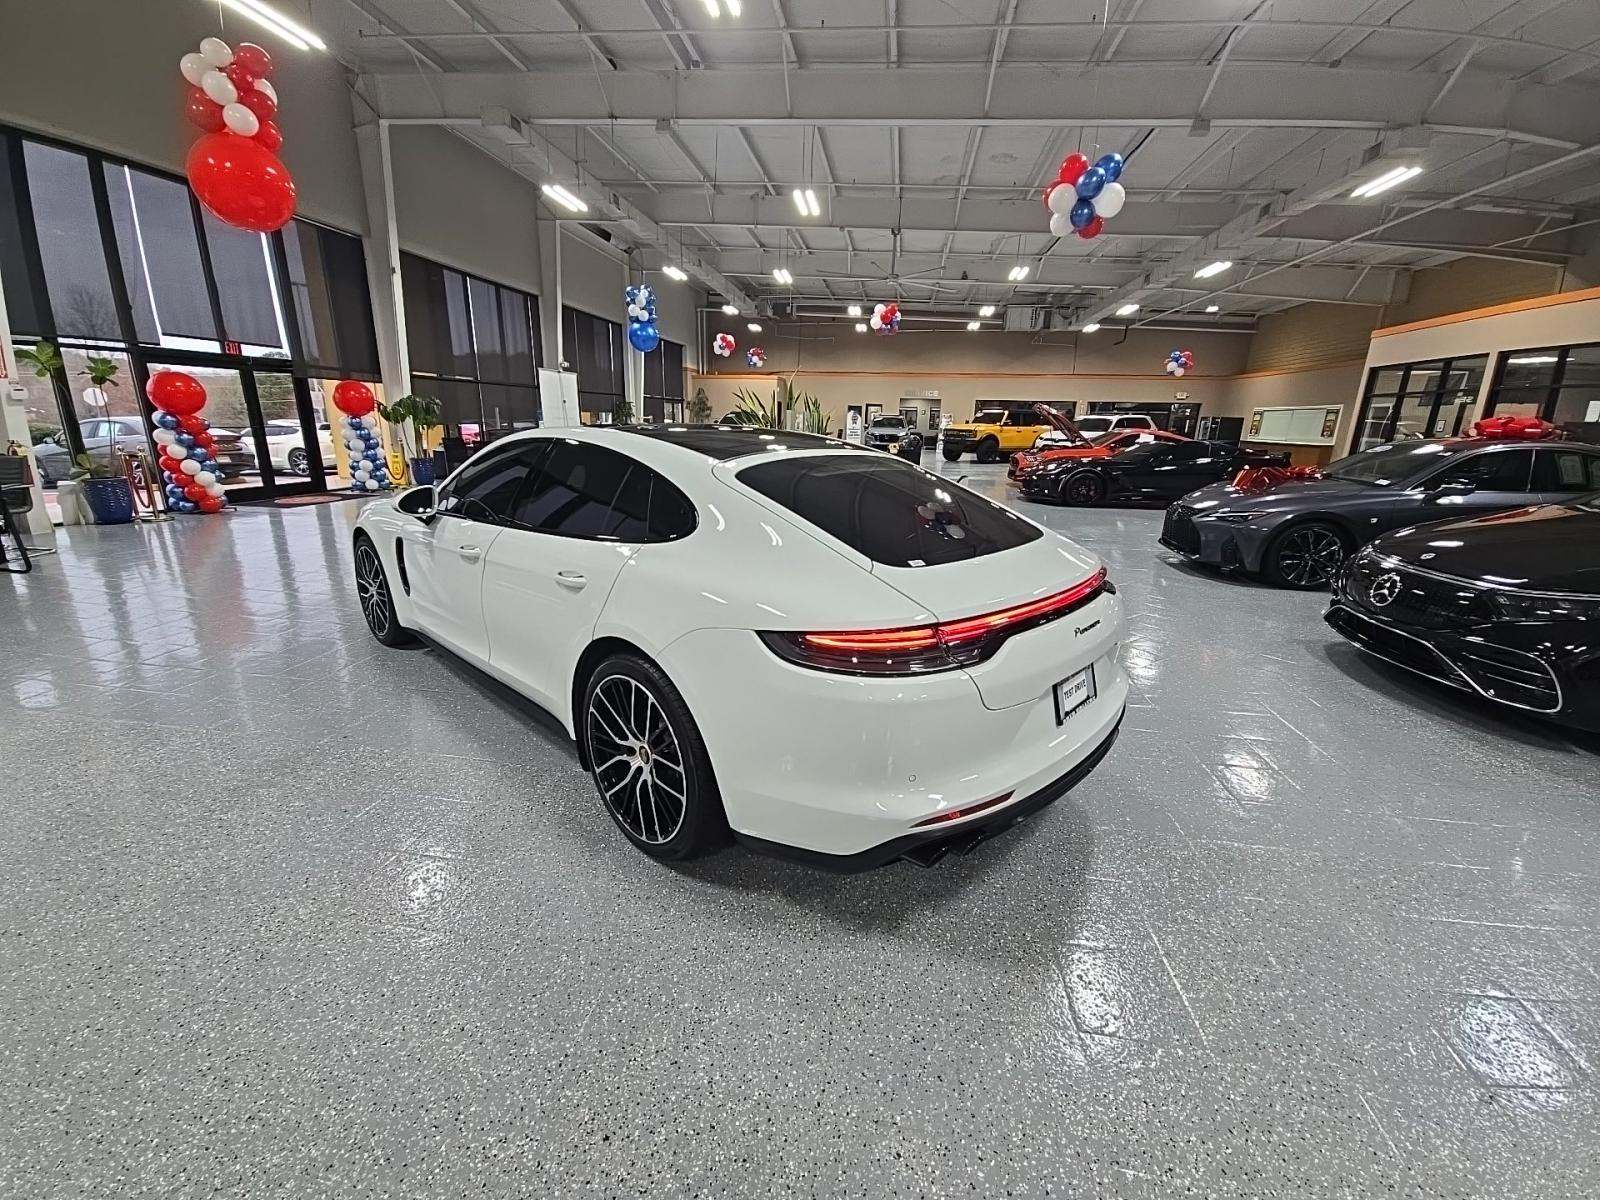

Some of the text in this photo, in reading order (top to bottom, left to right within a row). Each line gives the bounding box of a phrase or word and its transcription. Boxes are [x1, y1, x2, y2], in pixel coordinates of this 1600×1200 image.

[225, 341, 239, 354] EXIT
[1064, 679, 1087, 700] TEST DRIVE
